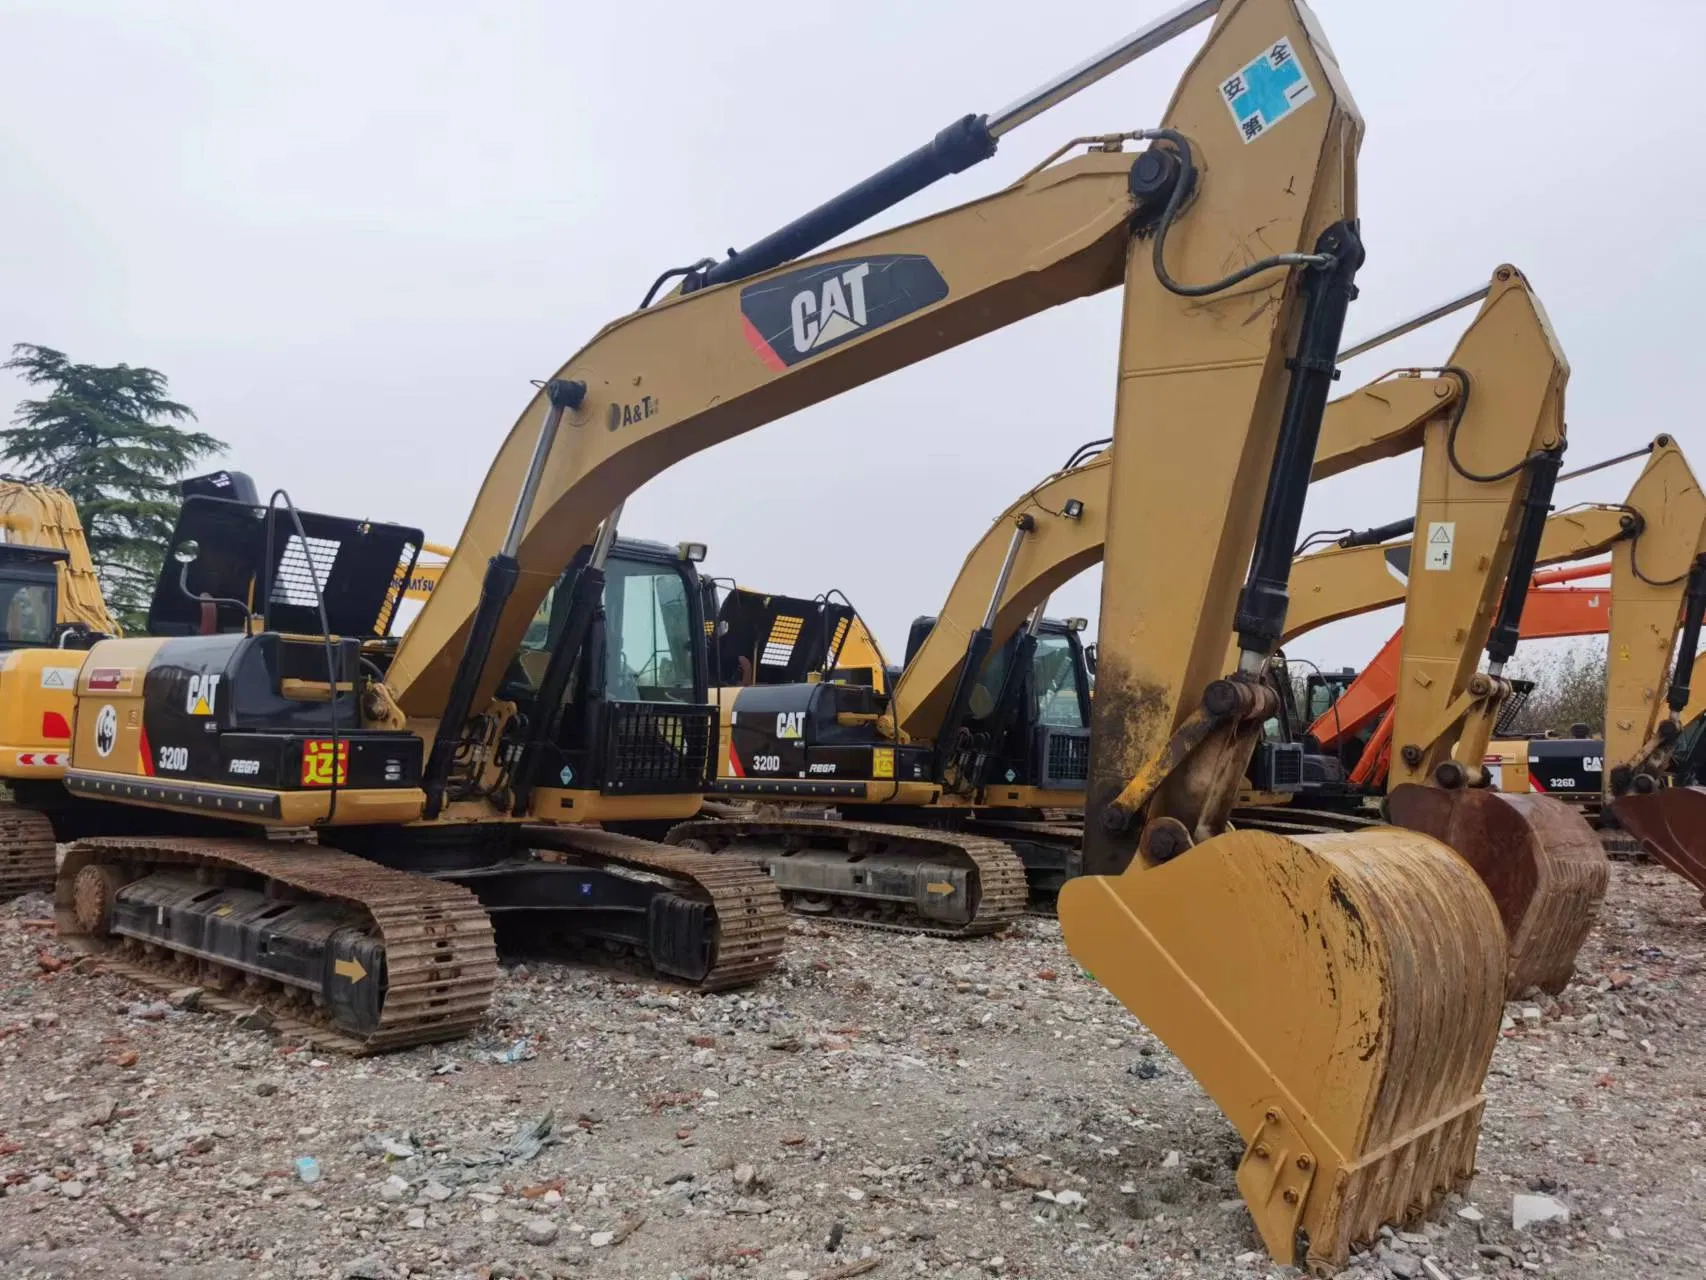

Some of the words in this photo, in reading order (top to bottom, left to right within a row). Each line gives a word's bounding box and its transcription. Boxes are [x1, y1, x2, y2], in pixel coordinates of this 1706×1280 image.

[791, 262, 869, 352] CAT
[187, 674, 221, 715] CAT
[776, 711, 806, 738] CAT
[159, 746, 189, 771] 320D
[304, 741, 346, 784] 运
[753, 755, 780, 771] 320D
[1550, 778, 1575, 788] 326D
